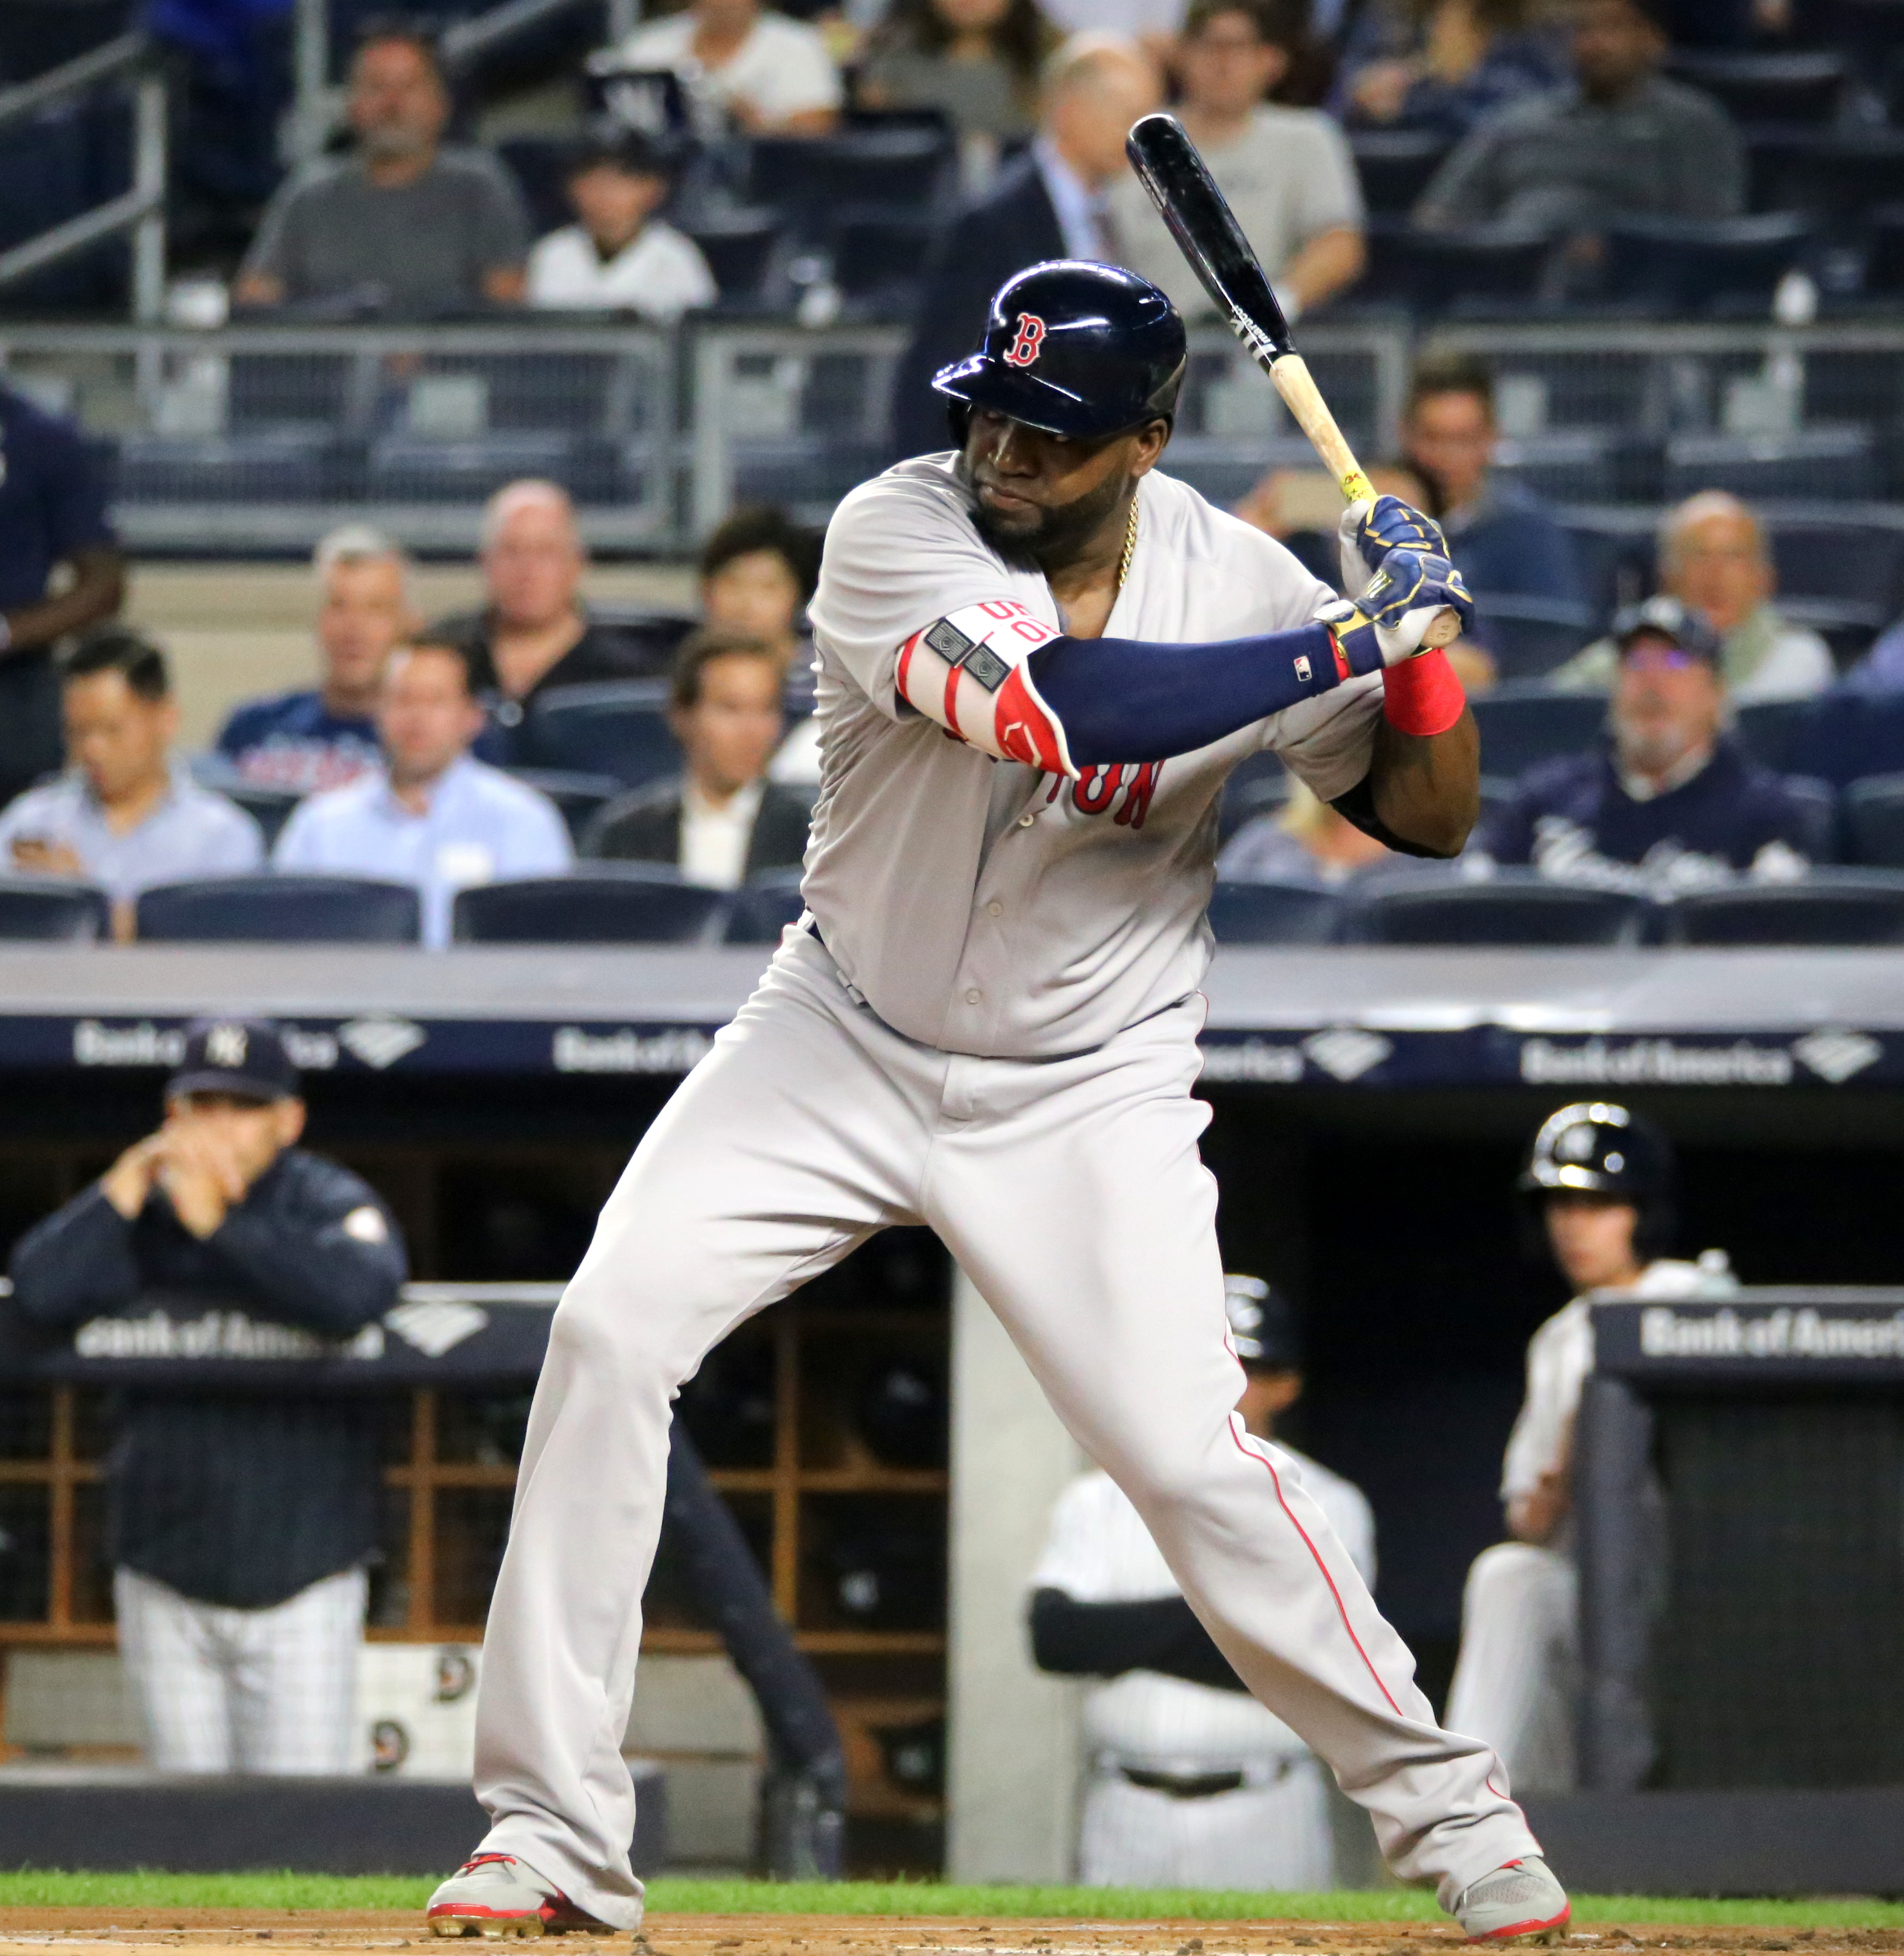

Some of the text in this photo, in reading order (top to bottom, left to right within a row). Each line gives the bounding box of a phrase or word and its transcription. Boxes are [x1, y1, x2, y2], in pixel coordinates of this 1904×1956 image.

[1003, 312, 1047, 367] B
[75, 1020, 187, 1066] Bank o
[553, 1026, 636, 1072] Bank
[1521, 1038, 1792, 1084] Bank of America
[1641, 1307, 1742, 1357] Bank
[1746, 1308, 1791, 1357] of
